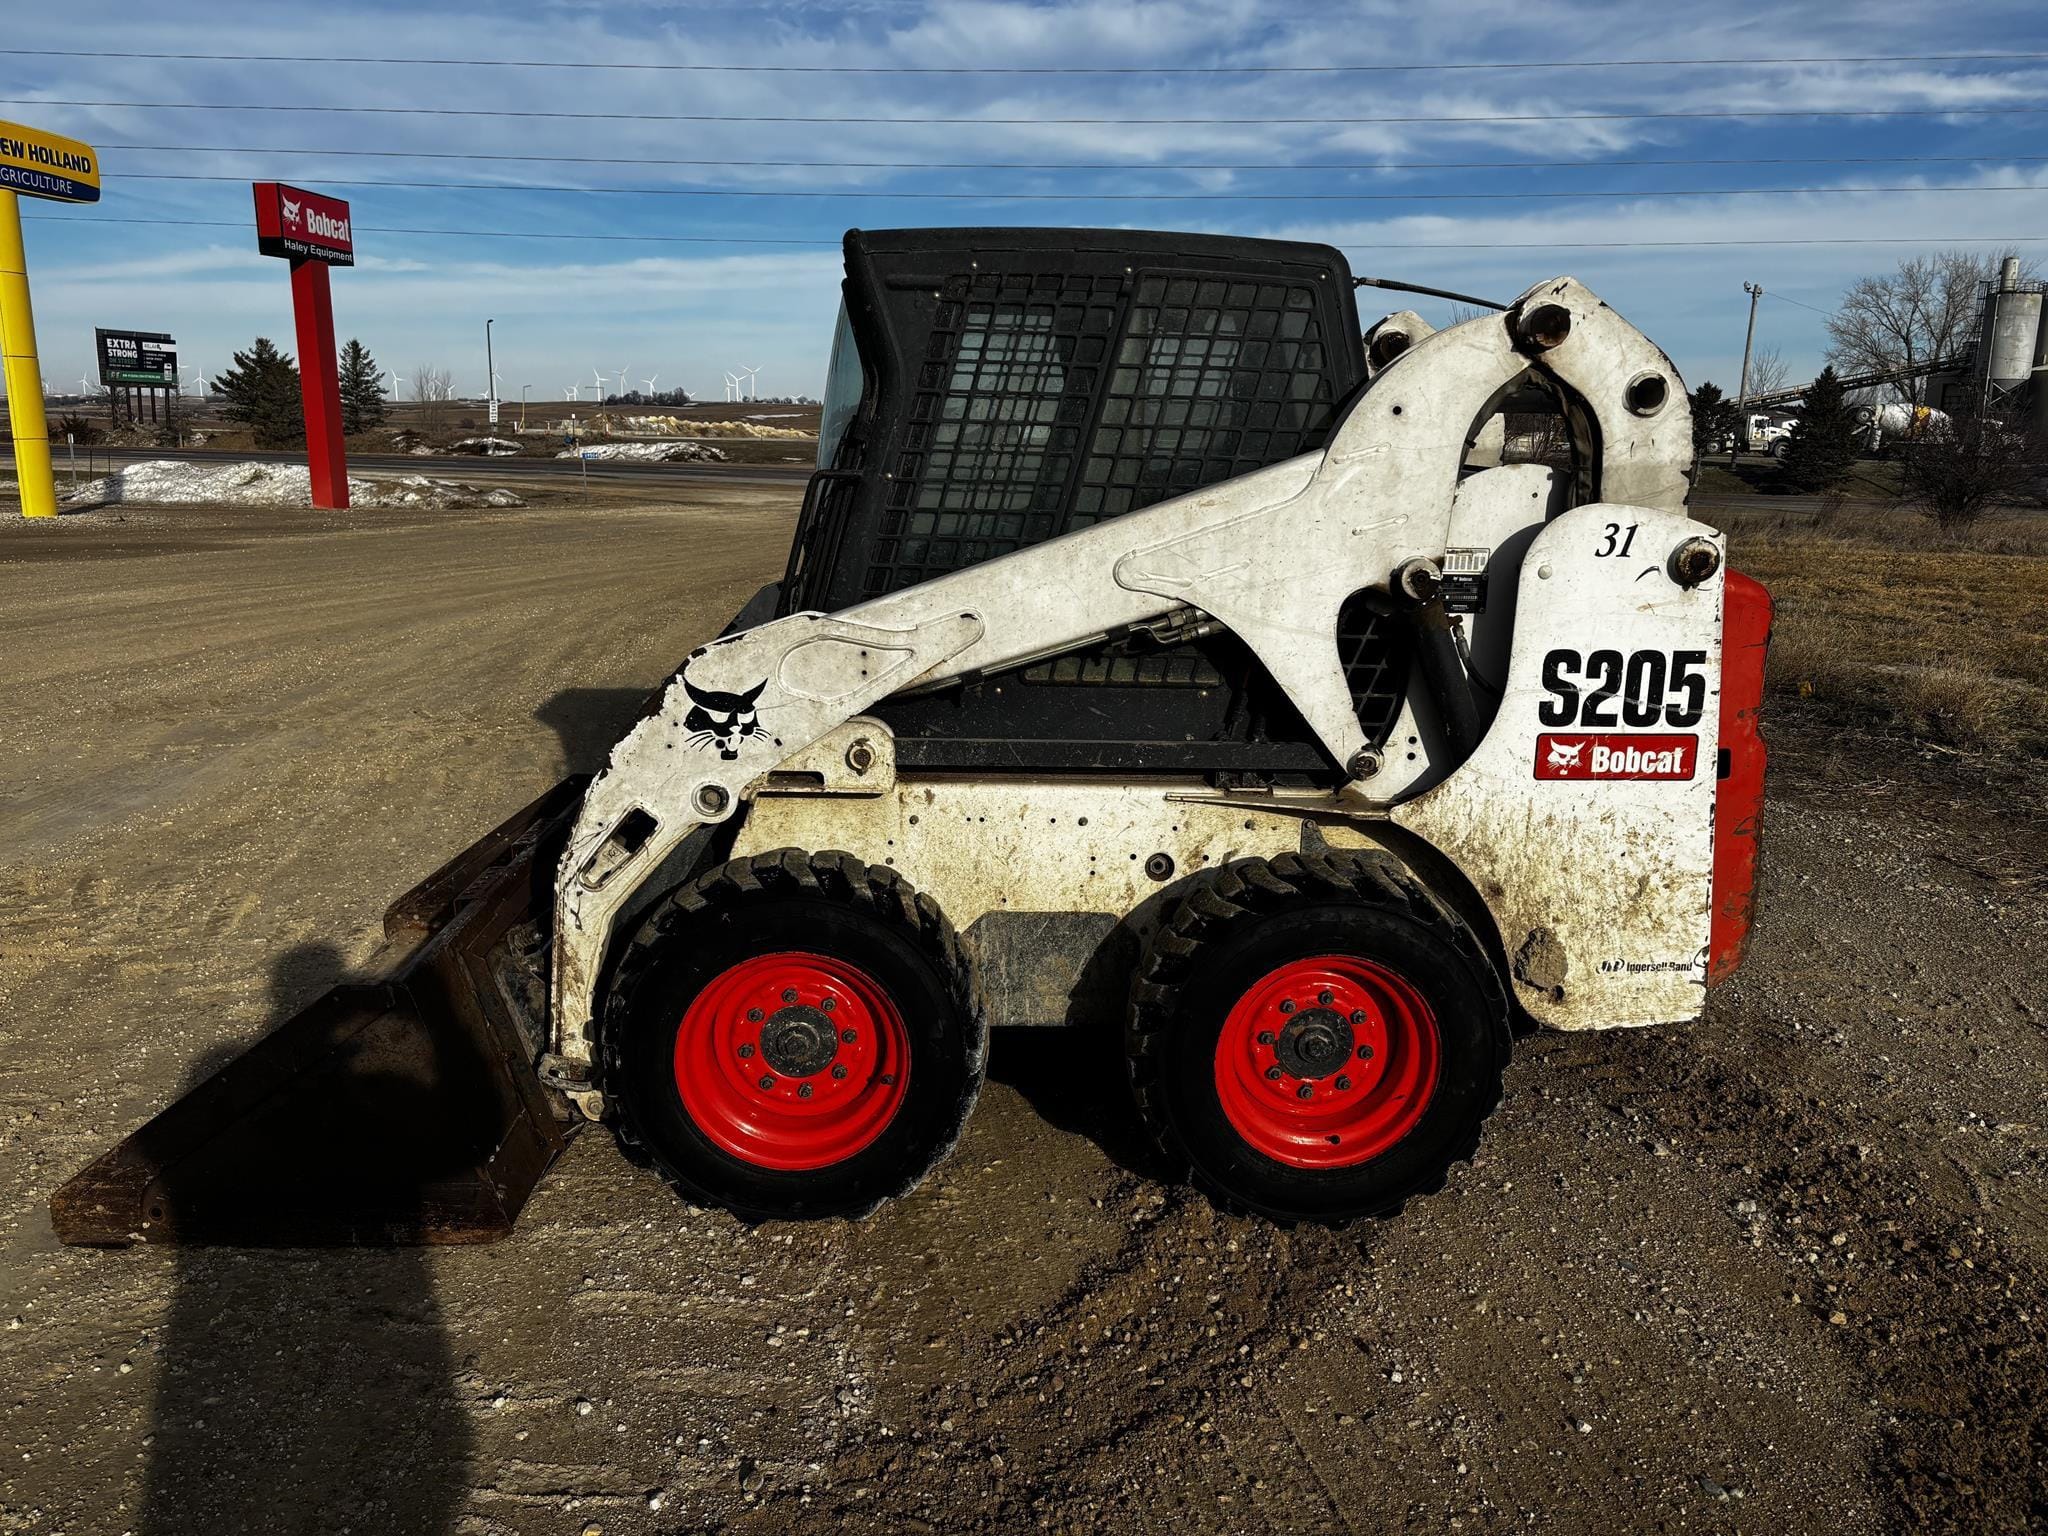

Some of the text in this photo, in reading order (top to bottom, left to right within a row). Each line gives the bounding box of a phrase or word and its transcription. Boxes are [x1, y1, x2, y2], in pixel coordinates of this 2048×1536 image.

[0, 137, 92, 174] EW HOLLAND
[0, 167, 73, 194] GRICULTURE
[306, 207, 350, 243] Bobcat
[284, 239, 353, 262] Haley Equipment
[106, 338, 137, 350] EXTRA
[108, 348, 138, 359] STRONG
[1594, 522, 1639, 558] 31
[1538, 648, 1707, 728] S205
[1590, 746, 1684, 774] Bobcat
